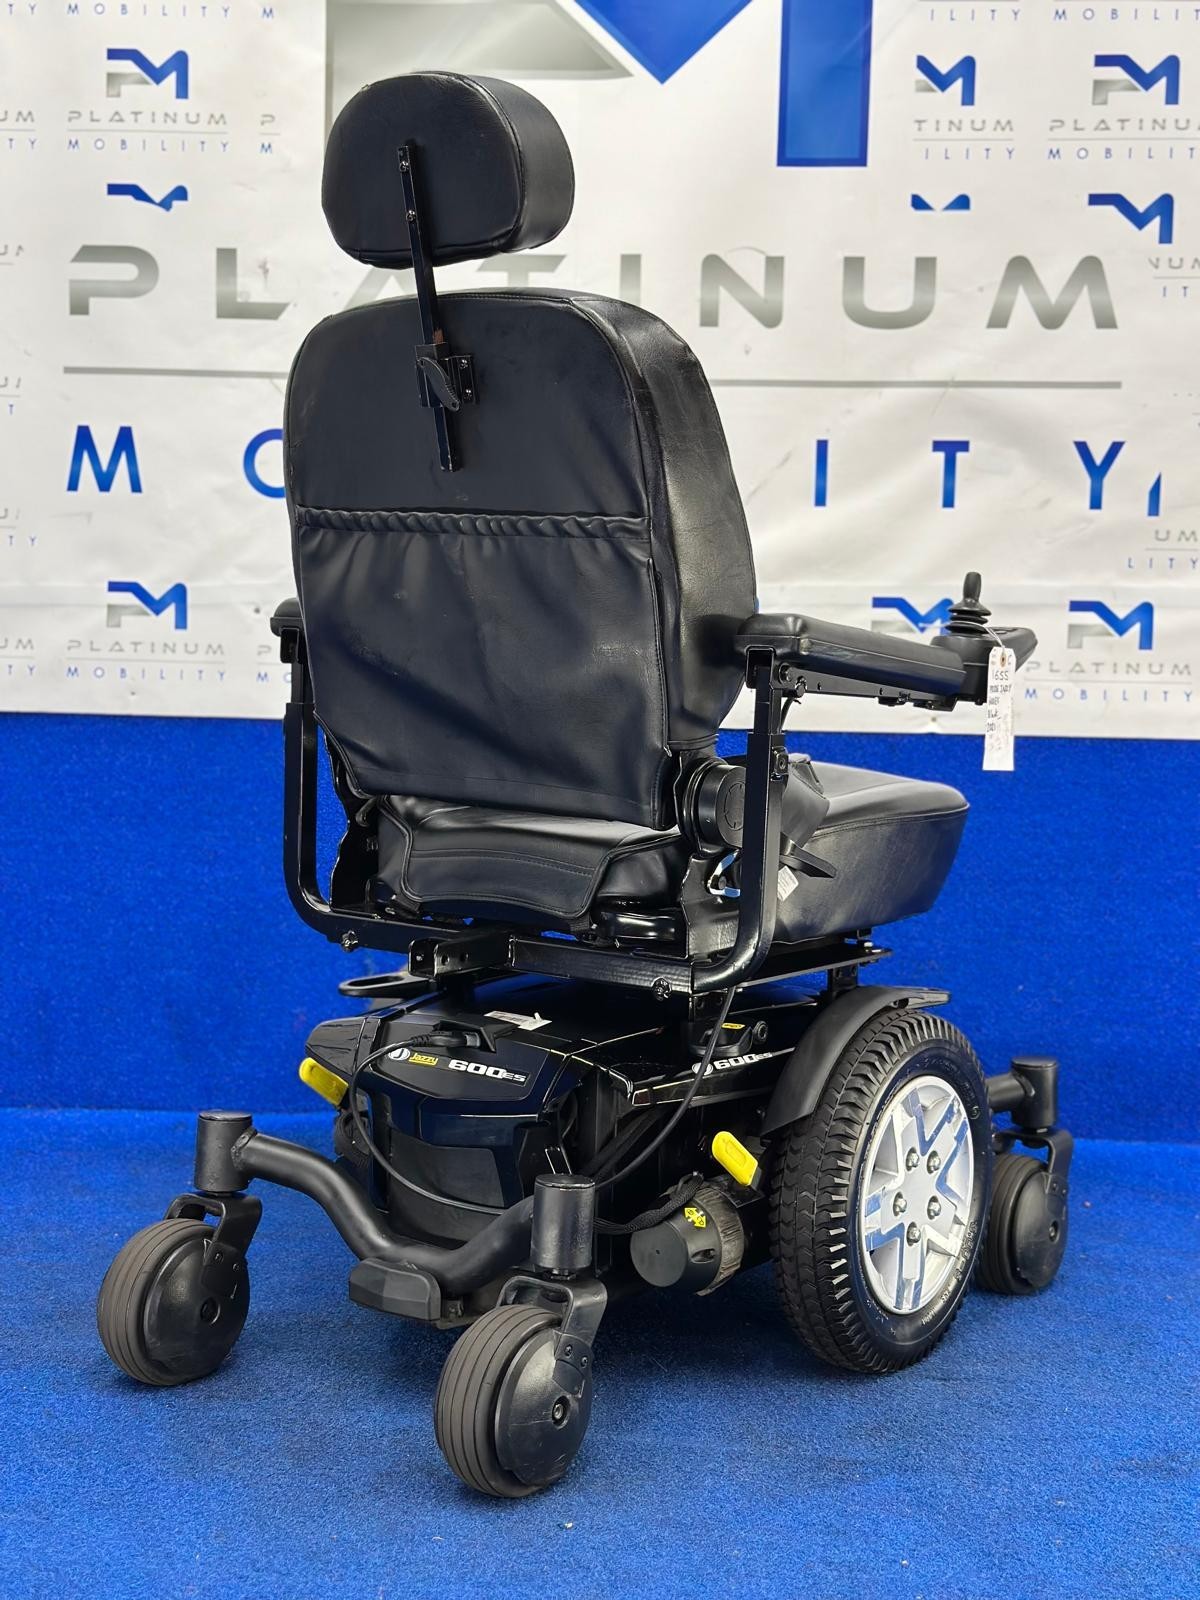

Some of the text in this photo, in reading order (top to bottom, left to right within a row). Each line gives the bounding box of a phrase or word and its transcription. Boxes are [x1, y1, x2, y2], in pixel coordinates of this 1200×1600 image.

[67, 3, 229, 17] MOBILITY
[68, 110, 226, 125] PLATINUM
[1049, 118, 1200, 132] PLATINU
[68, 138, 228, 152] MOBILITY
[67, 640, 224, 655] PLATINUM
[66, 667, 224, 680] MOBILITY
[1024, 658, 1191, 675] PLATINUM
[1025, 688, 1192, 701] MOBILITY
[411, 1052, 439, 1066] Jazzy
